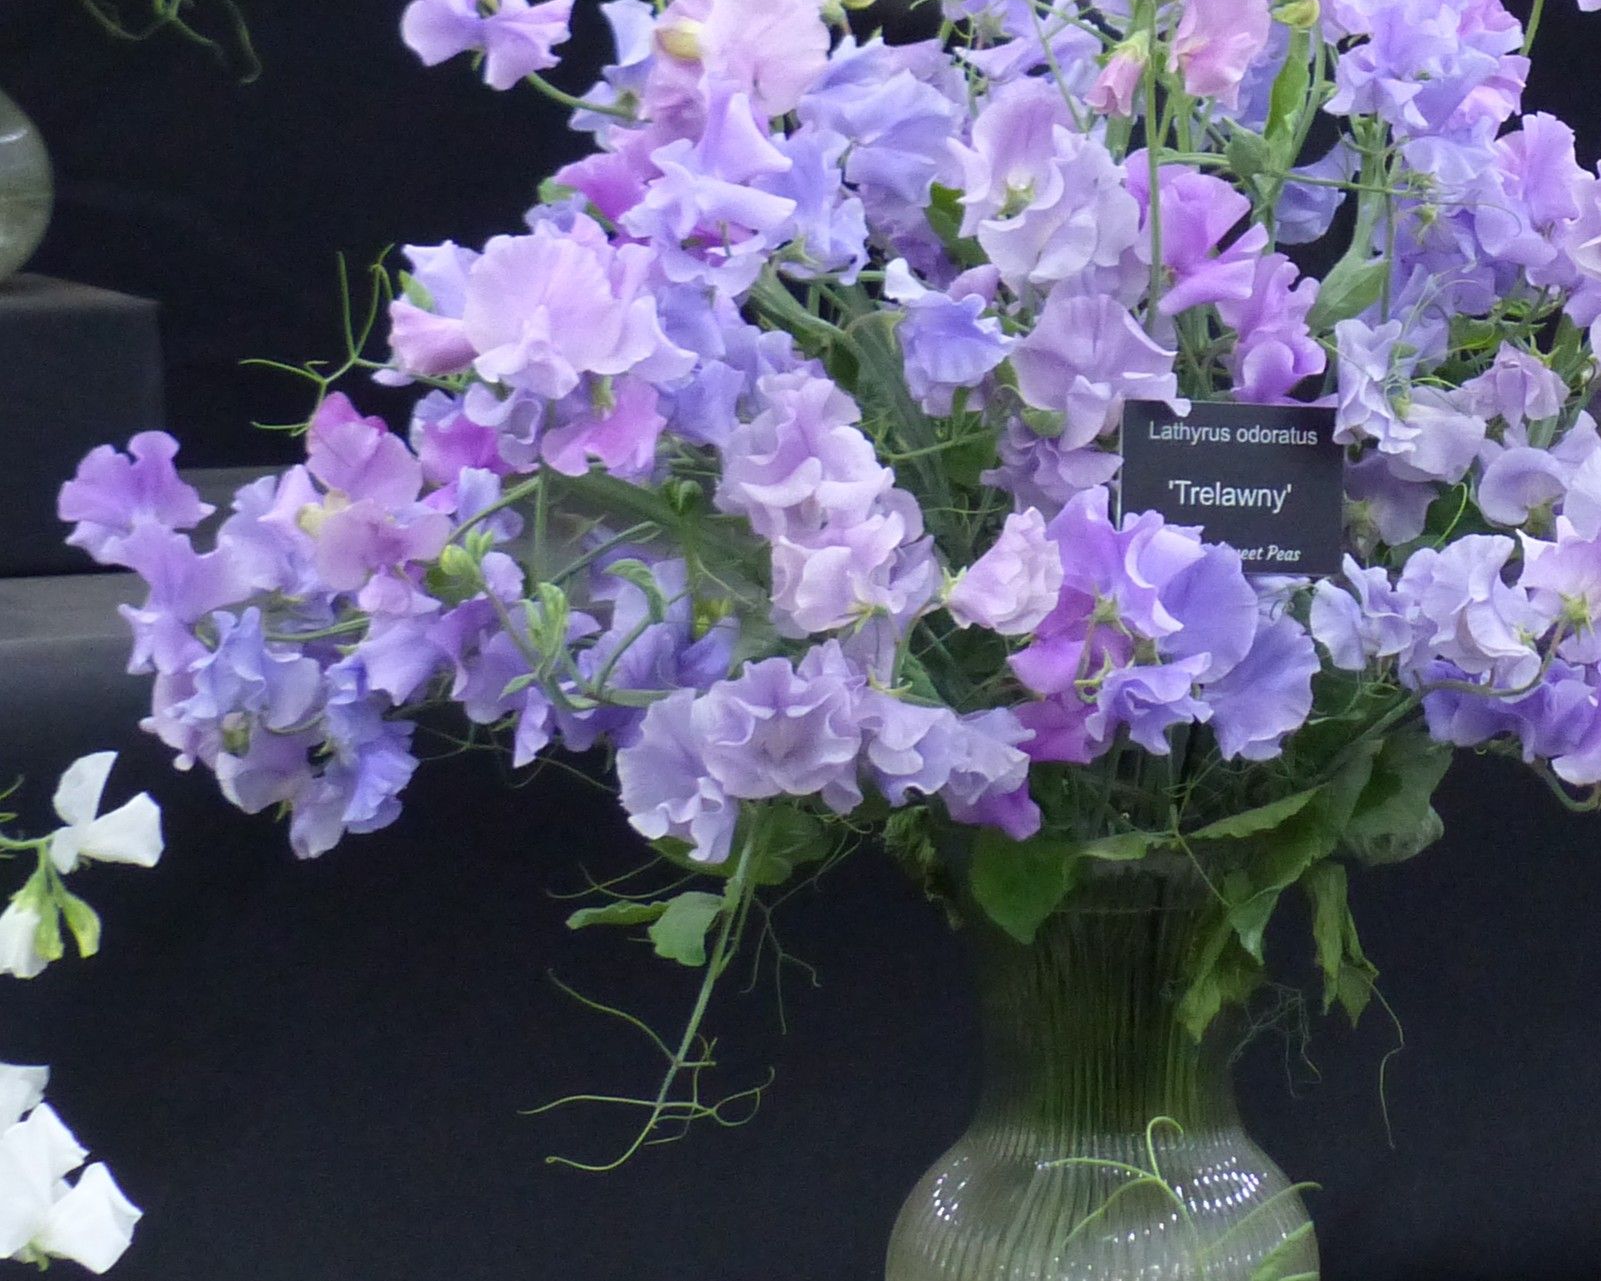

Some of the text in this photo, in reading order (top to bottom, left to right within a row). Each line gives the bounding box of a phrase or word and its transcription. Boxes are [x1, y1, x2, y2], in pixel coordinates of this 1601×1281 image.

[1149, 420, 1319, 446] Lathyrus odoratus
[1168, 480, 1292, 514] 'Trelawny'
[1266, 544, 1302, 562] Peas
